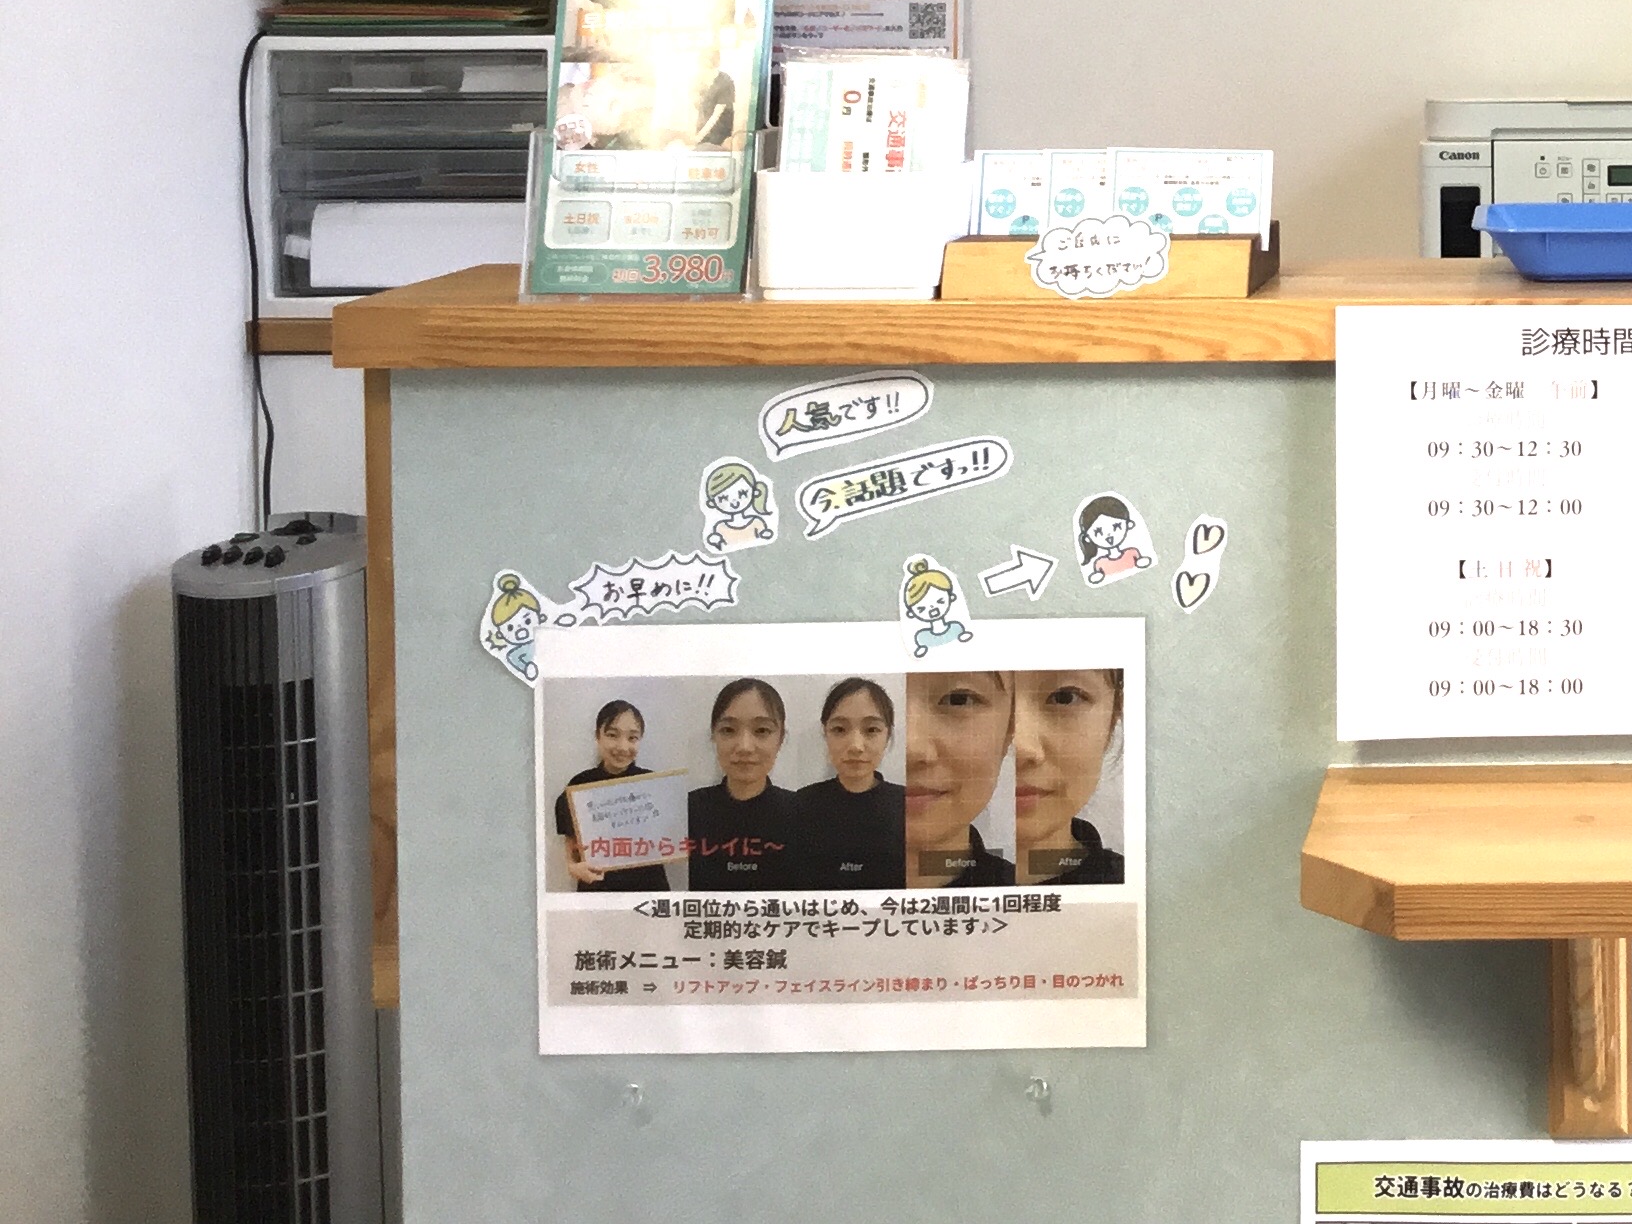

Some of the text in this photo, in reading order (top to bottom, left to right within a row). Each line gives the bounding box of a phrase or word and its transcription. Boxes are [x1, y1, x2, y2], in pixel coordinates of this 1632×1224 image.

[885, 111, 907, 172] 交通事
[1439, 150, 1480, 161] Canon
[727, 860, 758, 873] Before
[840, 860, 864, 873] After
[945, 857, 977, 869] Before
[1058, 856, 1083, 868] After
[570, 980, 629, 997] 施術効果
